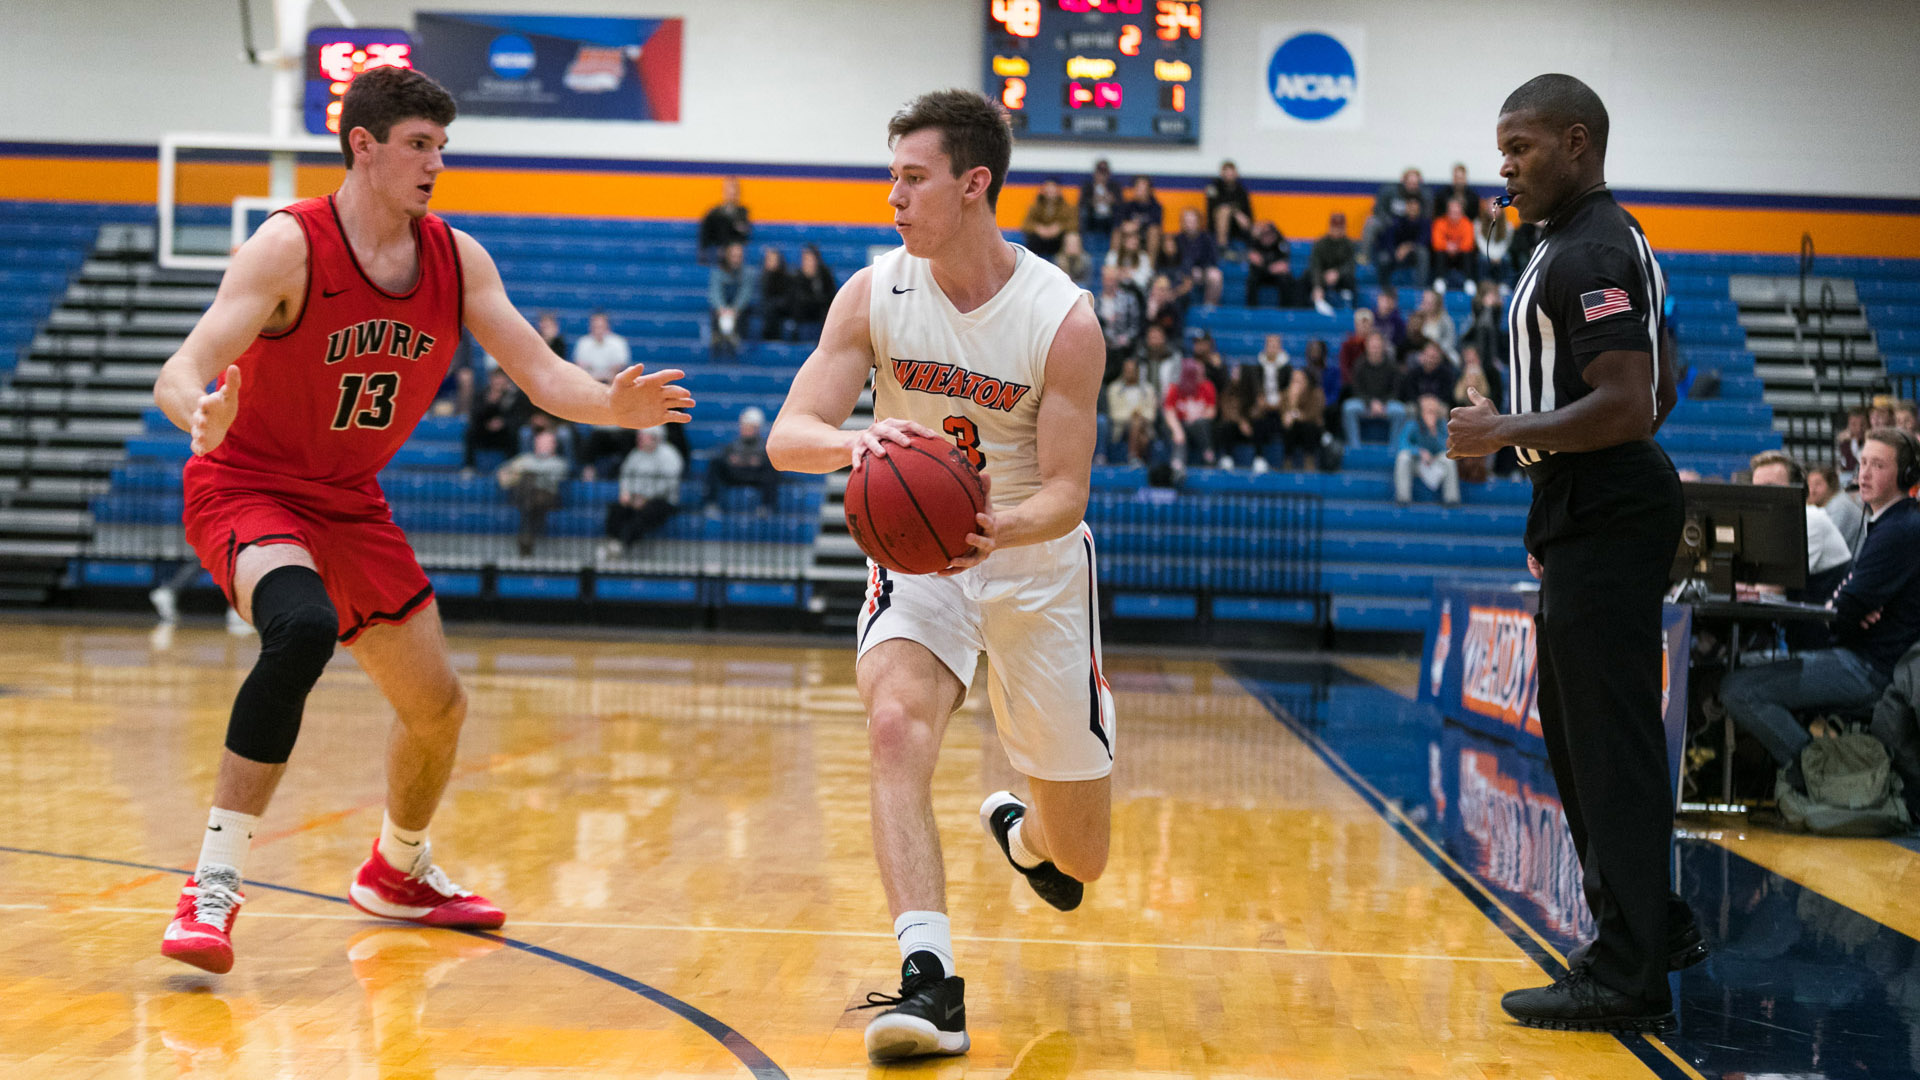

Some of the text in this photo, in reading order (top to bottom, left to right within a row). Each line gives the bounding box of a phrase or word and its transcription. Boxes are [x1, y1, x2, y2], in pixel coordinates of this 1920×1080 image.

[1119, 24, 1143, 57] 2
[1155, 1, 1202, 41] 34
[1002, 77, 1027, 109] 2
[1275, 73, 1355, 101] NCAA
[324, 319, 437, 365] UWRF
[330, 371, 401, 431] 13
[891, 357, 1031, 412] WHEATON
[943, 415, 987, 472] 3
